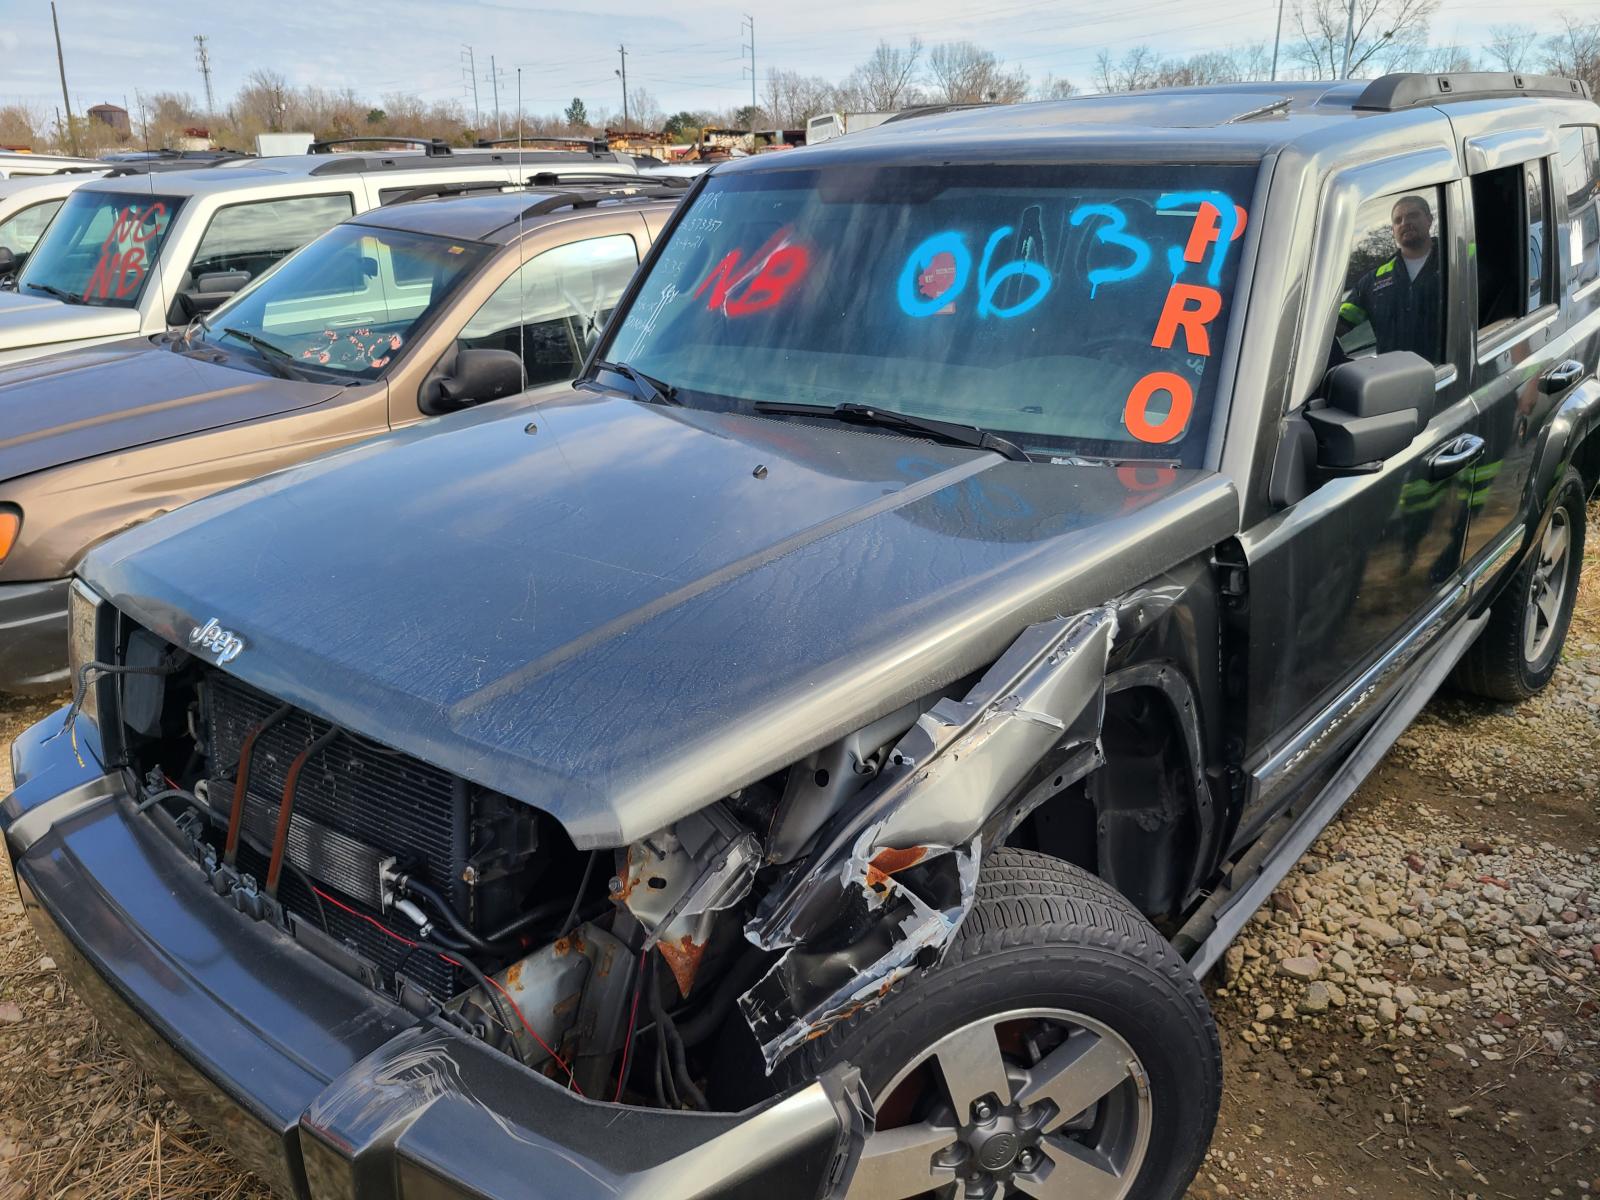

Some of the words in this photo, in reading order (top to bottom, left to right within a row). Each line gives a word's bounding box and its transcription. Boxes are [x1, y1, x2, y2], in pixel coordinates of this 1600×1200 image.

[83, 246, 146, 302] NB
[693, 222, 810, 318] NB
[189, 617, 243, 667] Jeep
